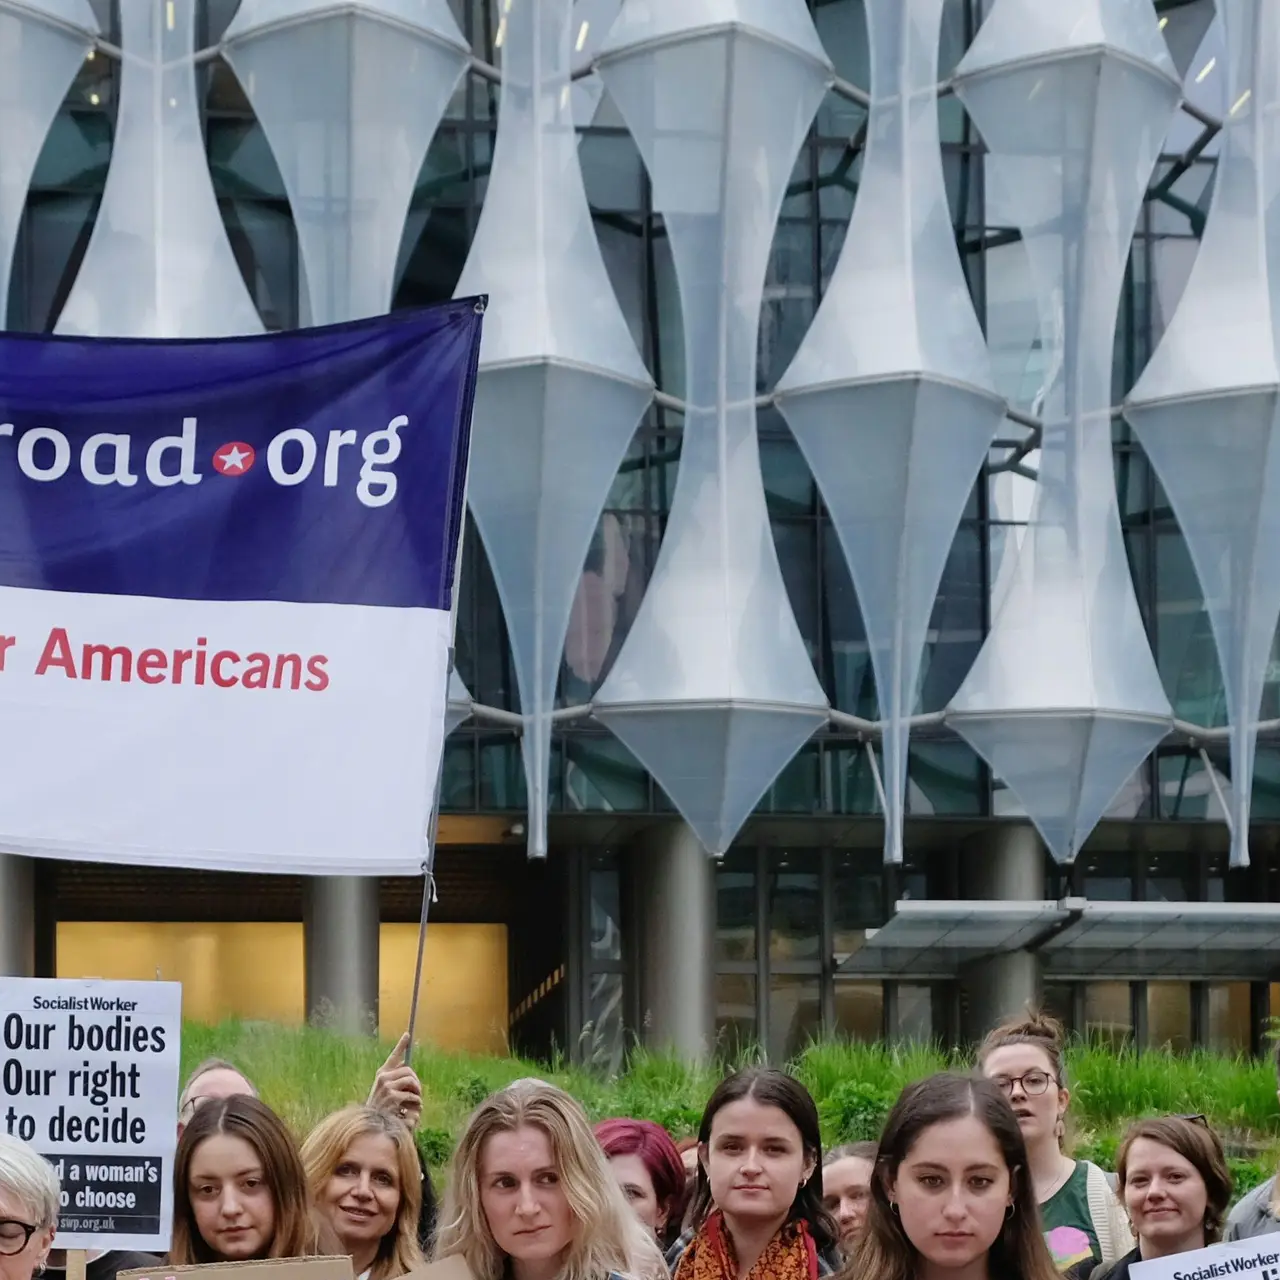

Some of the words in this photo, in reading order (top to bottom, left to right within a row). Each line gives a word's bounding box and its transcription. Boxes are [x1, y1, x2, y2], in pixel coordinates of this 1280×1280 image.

[34, 627, 330, 691] Americans
[3, 1013, 55, 1050] Our
[68, 1014, 165, 1053] bodies
[3, 1058, 56, 1096] Our
[68, 1061, 140, 1106] right
[5, 1106, 36, 1141] to
[48, 1105, 146, 1144] decide
[70, 1165, 80, 1181] a
[86, 1160, 158, 1183] woman's
[75, 1187, 136, 1209] choose
